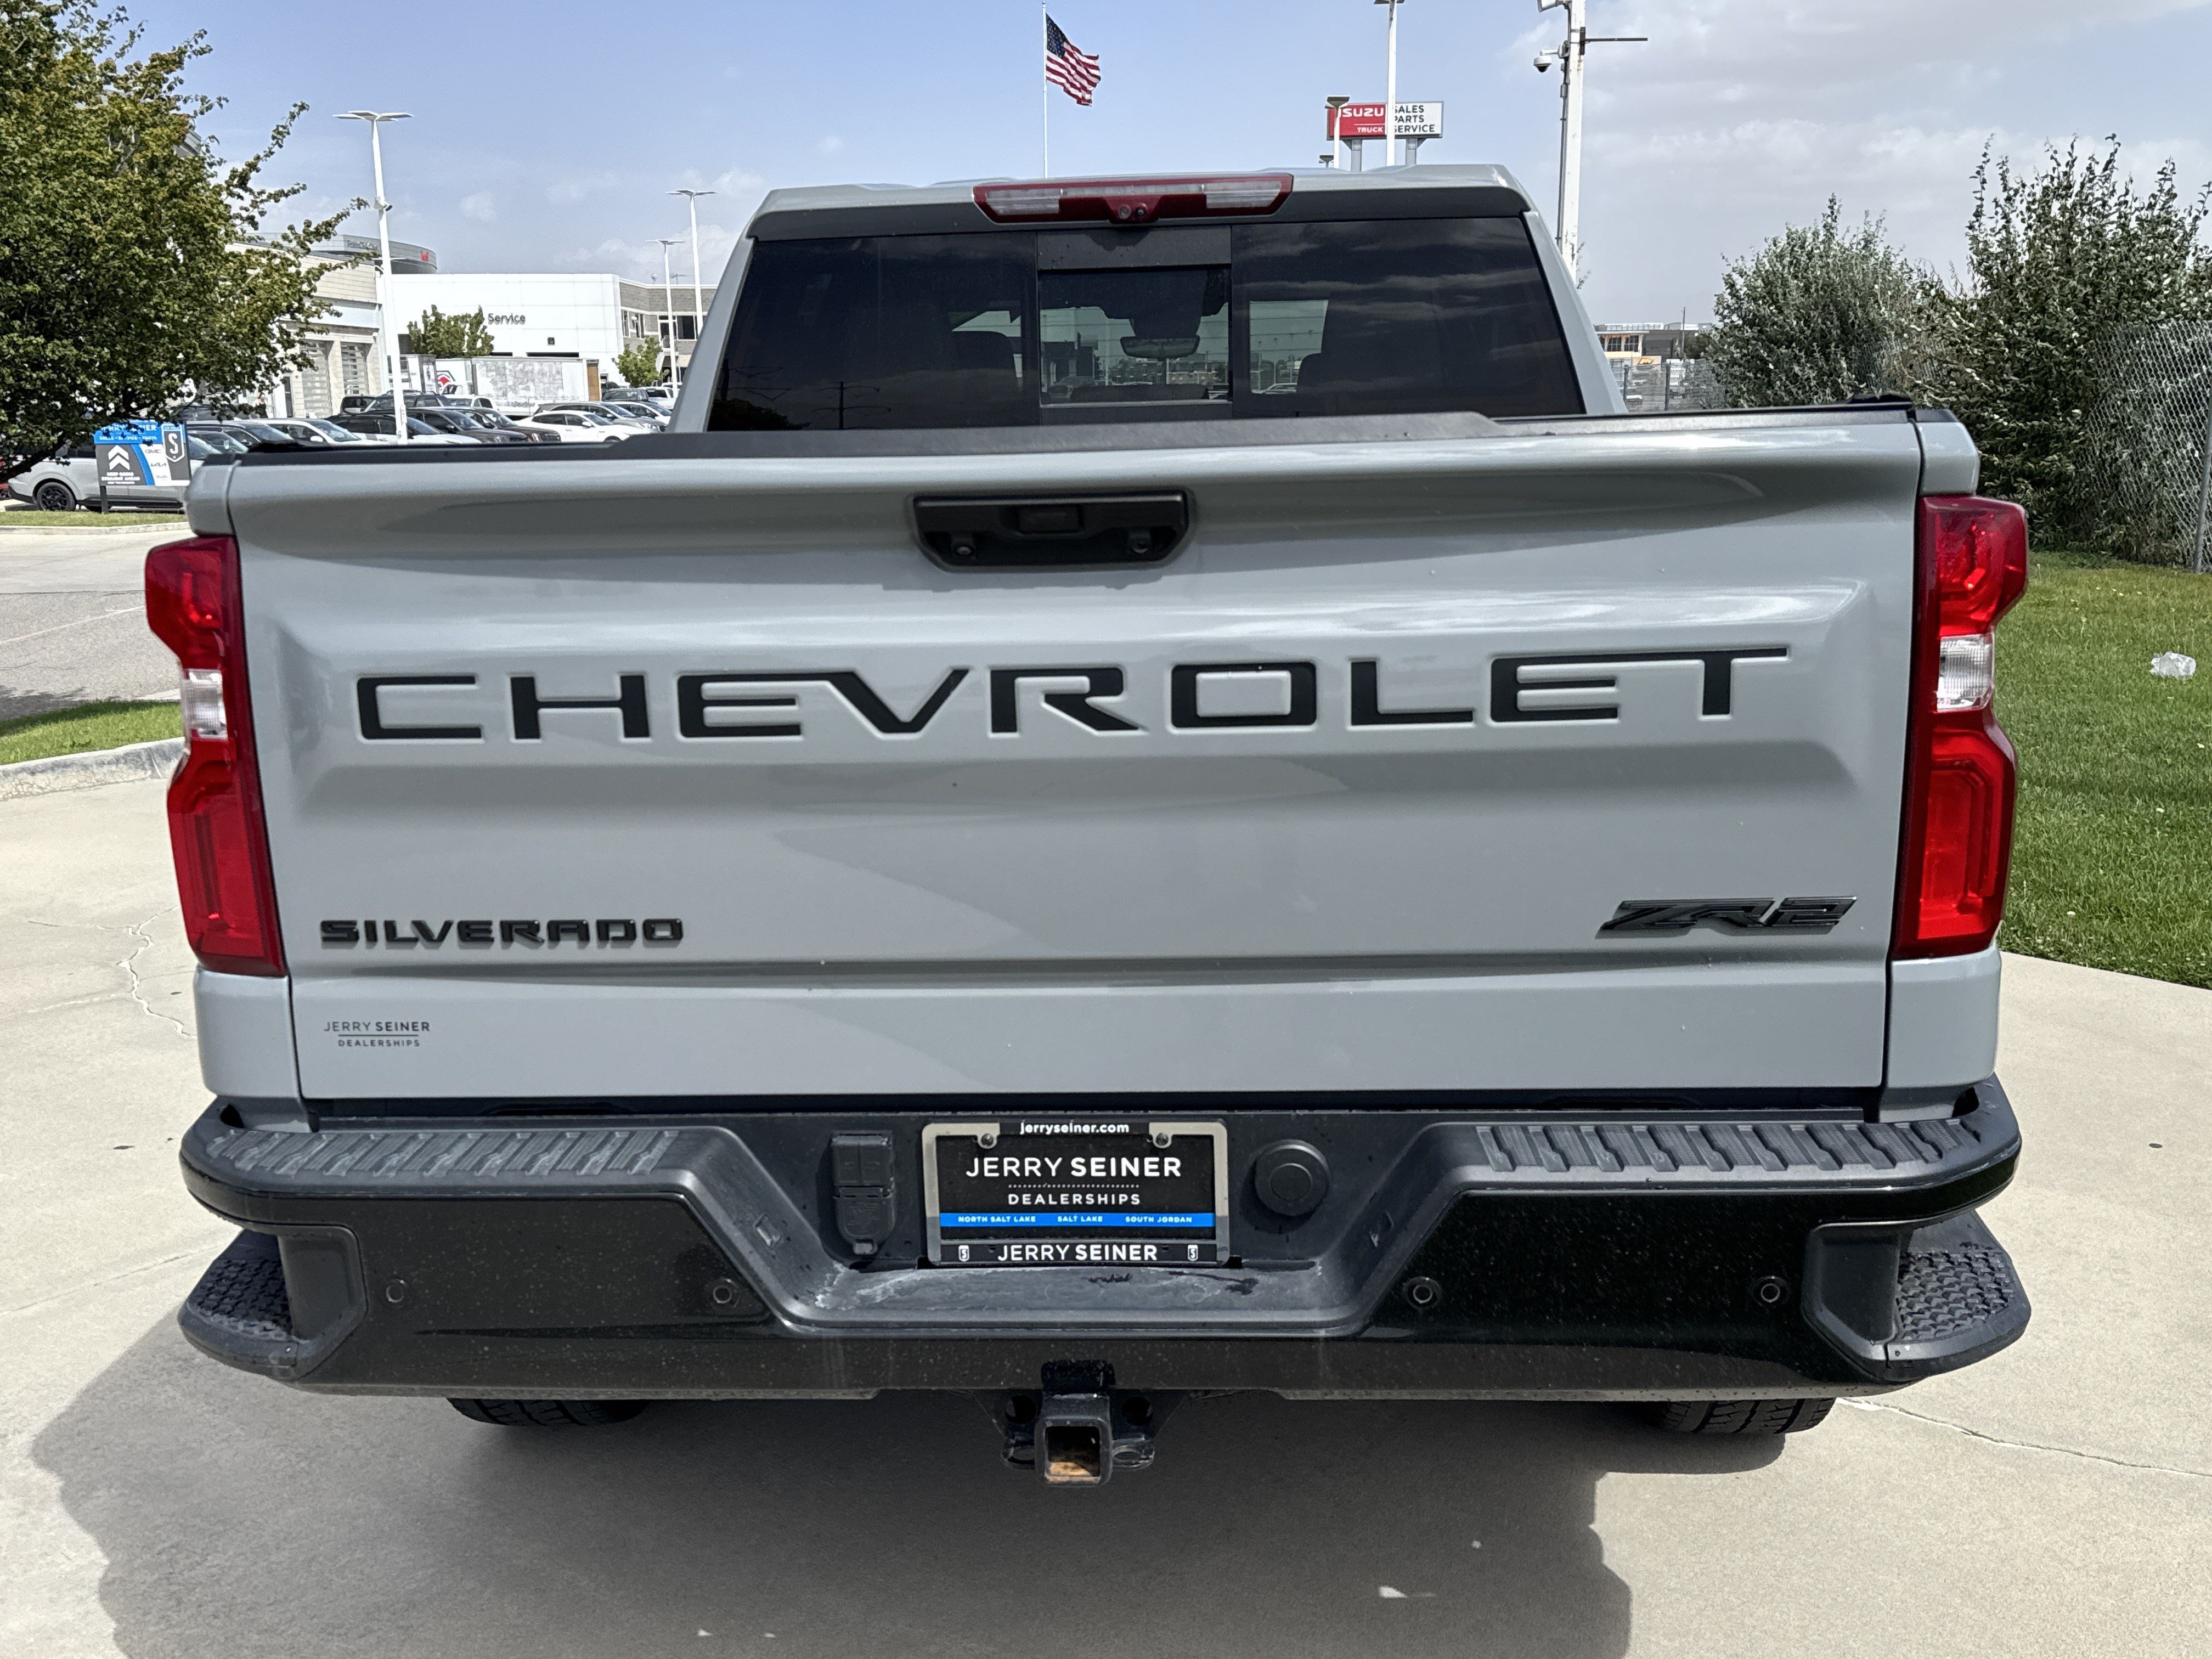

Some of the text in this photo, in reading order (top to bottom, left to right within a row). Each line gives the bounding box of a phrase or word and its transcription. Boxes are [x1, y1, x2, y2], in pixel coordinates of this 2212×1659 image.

[488, 313, 526, 323] Service
[357, 648, 1788, 739] CHEVROLET
[1600, 895, 1858, 930] ZR2
[320, 918, 684, 943] SILVERADO
[324, 1022, 430, 1031] JERRY SEINER
[1019, 1119, 1130, 1135] jerryseiner.com
[966, 1157, 1181, 1177] JERRY SEINER
[1008, 1193, 1140, 1205] DEALERSHIPS
[997, 1244, 1157, 1261] JERRY SEINER
